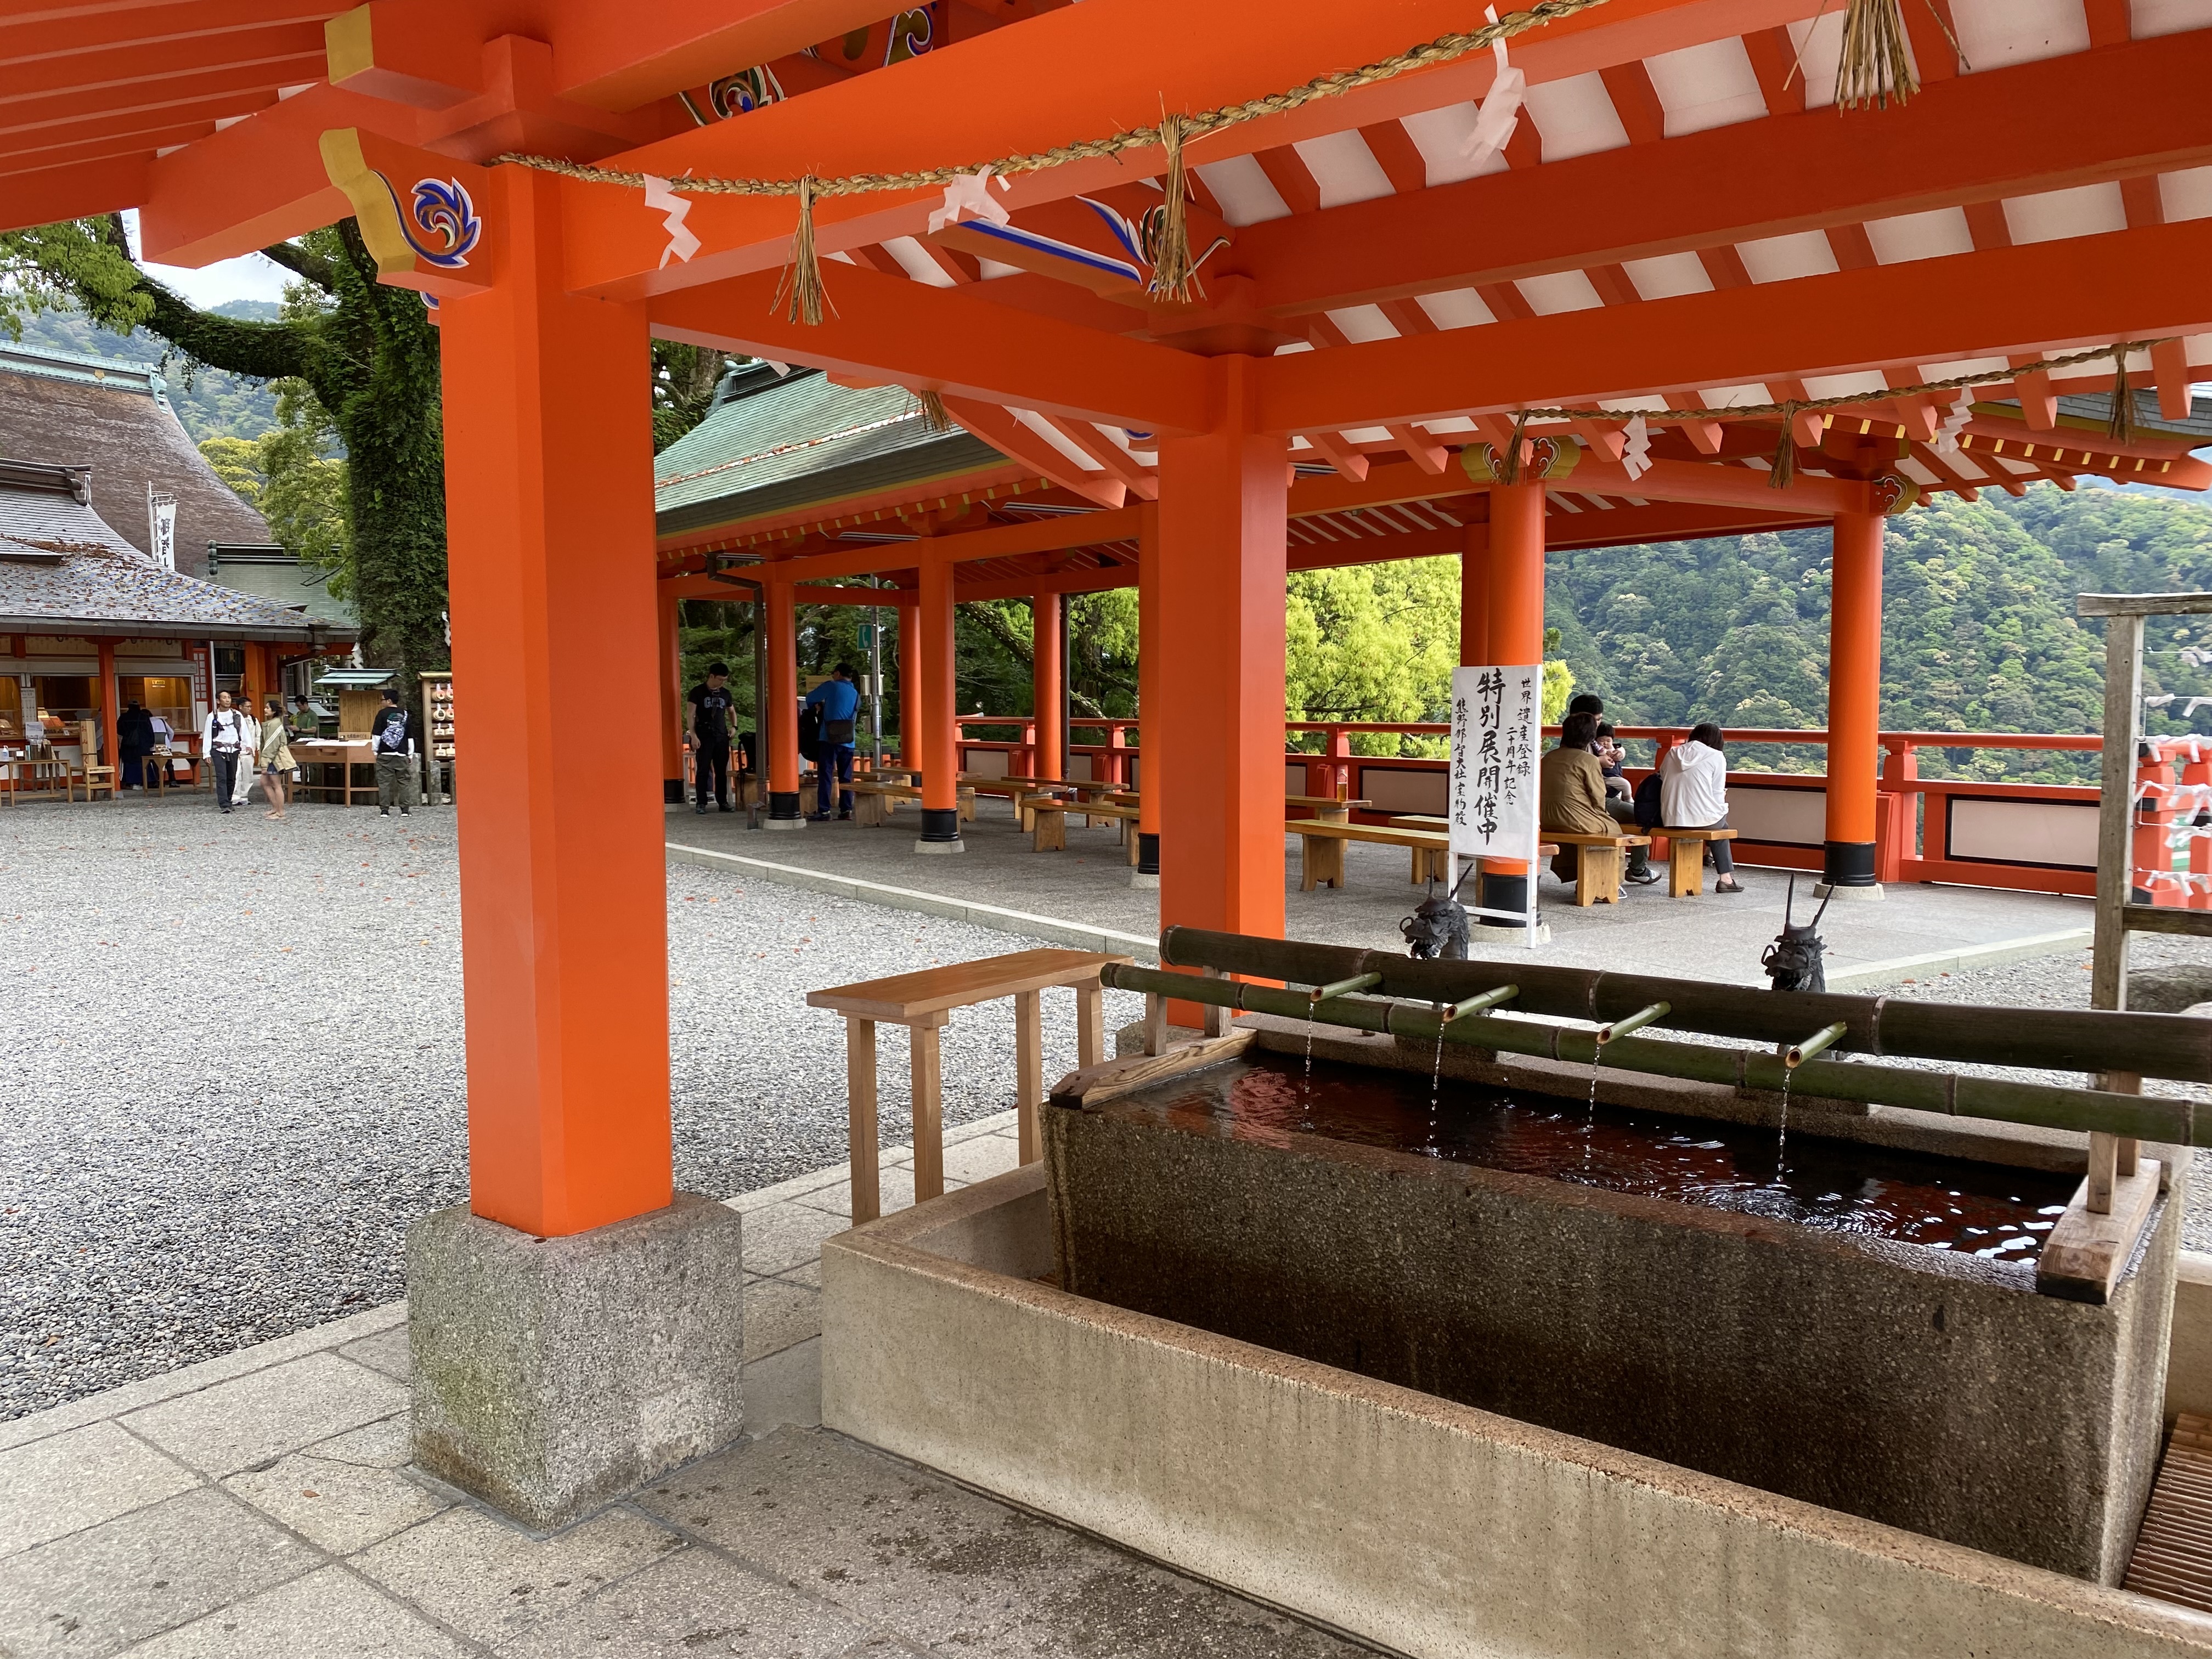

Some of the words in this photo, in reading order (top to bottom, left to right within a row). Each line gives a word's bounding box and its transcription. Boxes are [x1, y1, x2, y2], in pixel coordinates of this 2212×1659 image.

[1453, 697, 1469, 826] 熊野那智大社宝物殿
[1474, 667, 1506, 845] 特別展開催中
[1504, 726, 1517, 805] 二十周年記念
[1516, 677, 1532, 777] 世界遺産登録
